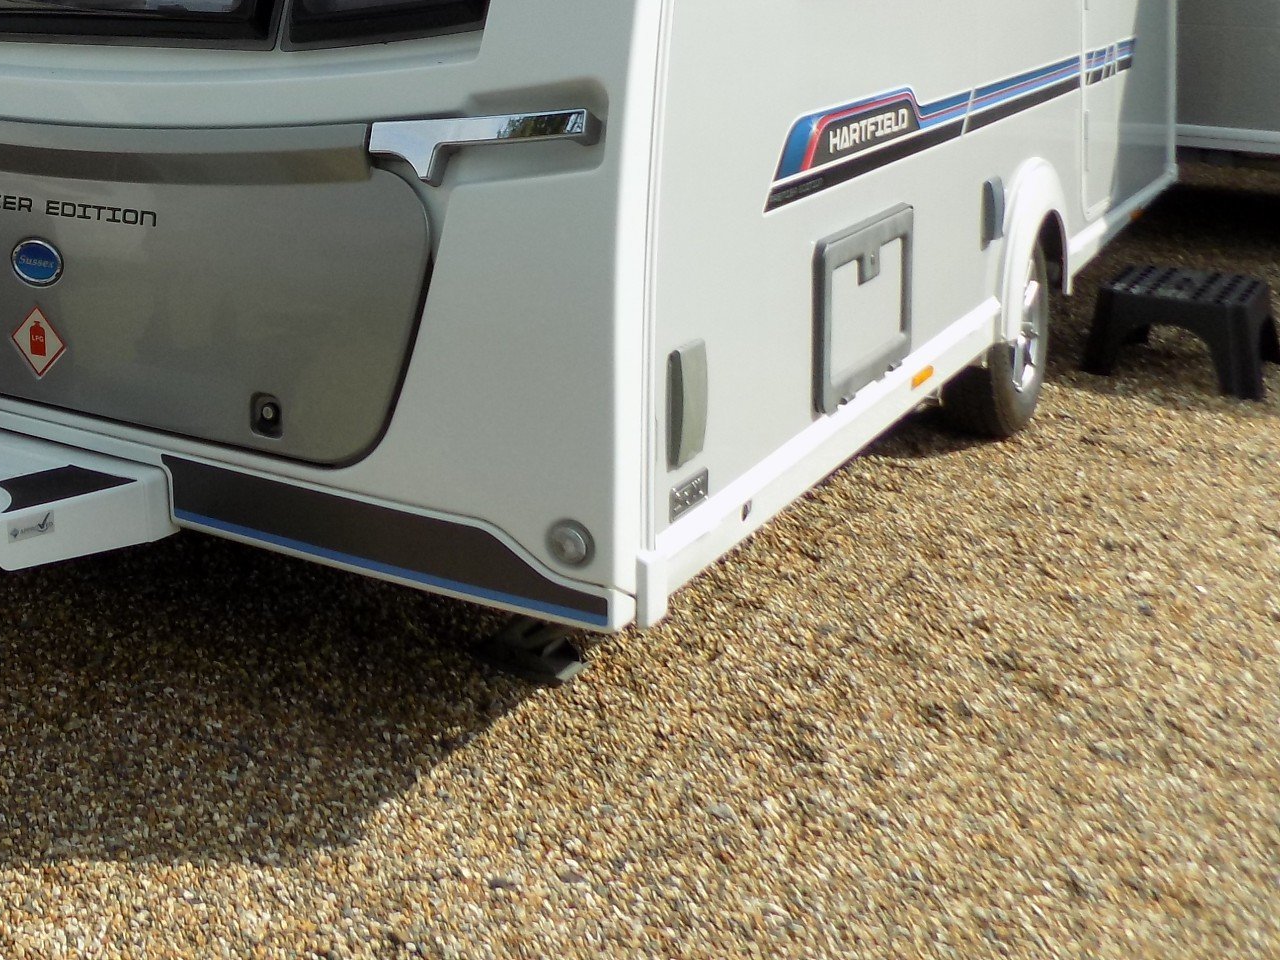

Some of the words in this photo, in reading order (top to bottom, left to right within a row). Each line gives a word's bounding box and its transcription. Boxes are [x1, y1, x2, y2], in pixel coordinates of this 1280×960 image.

[828, 108, 908, 154] HARTFIELD
[45, 199, 157, 227] EDITION
[19, 254, 55, 269] Sussex
[31, 334, 44, 343] LPG
